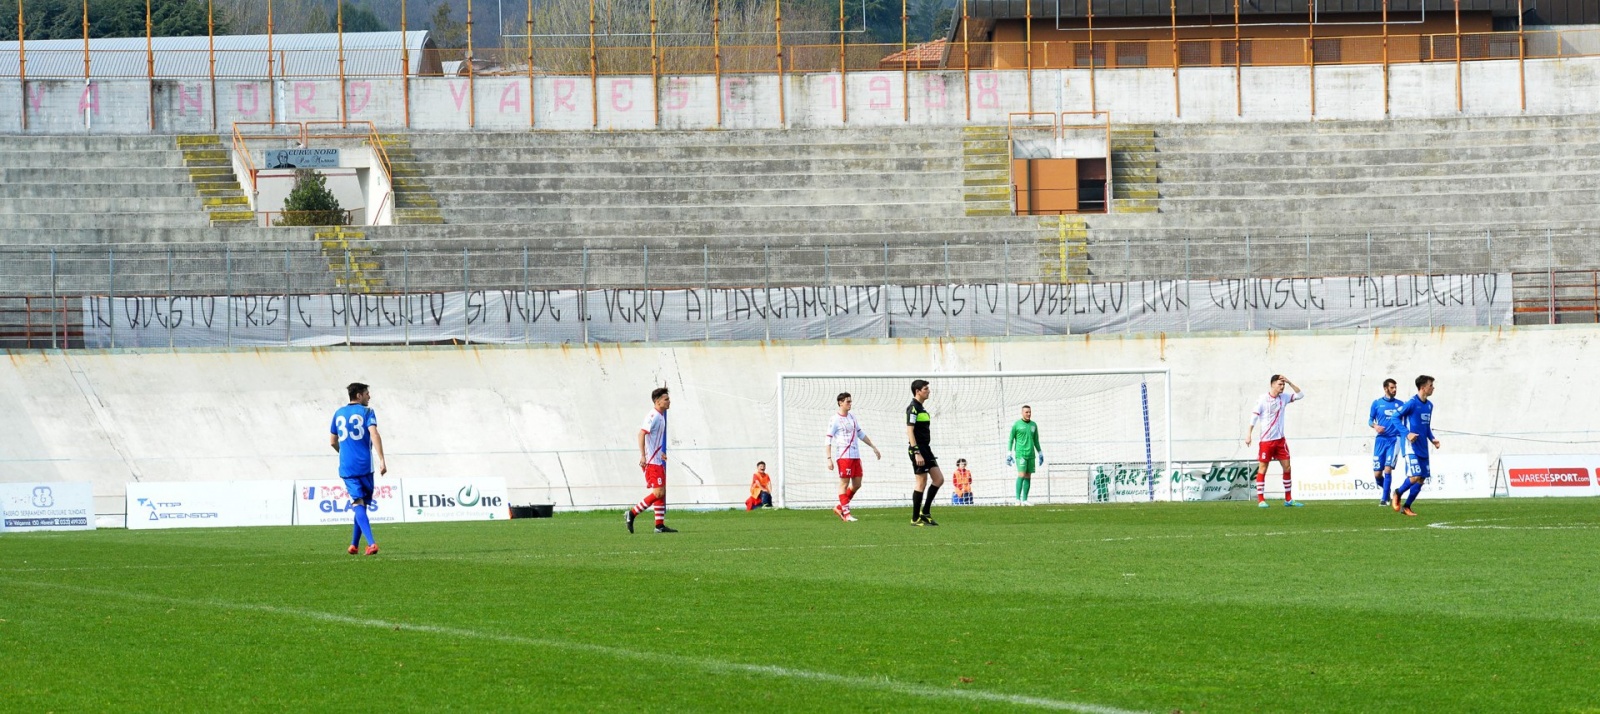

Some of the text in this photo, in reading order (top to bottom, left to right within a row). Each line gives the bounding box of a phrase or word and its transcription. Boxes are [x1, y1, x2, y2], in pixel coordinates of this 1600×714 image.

[179, 81, 371, 116] NORD
[125, 296, 214, 329] QUESTO
[331, 293, 444, 327] MOMENTO
[467, 290, 487, 324] SI
[499, 290, 560, 322] VEDE
[604, 288, 665, 322] VERO
[686, 285, 880, 321] ATTACCAMENTO
[901, 284, 998, 317] QUESTO
[1016, 284, 1123, 315] PUBBLICO
[1141, 279, 1188, 313] NON
[1209, 276, 1323, 310] CONOSCE
[335, 413, 365, 442] 33
[1410, 465, 1422, 474] 18
[319, 500, 379, 513] GLAS
[409, 483, 502, 508] LEDisOne
